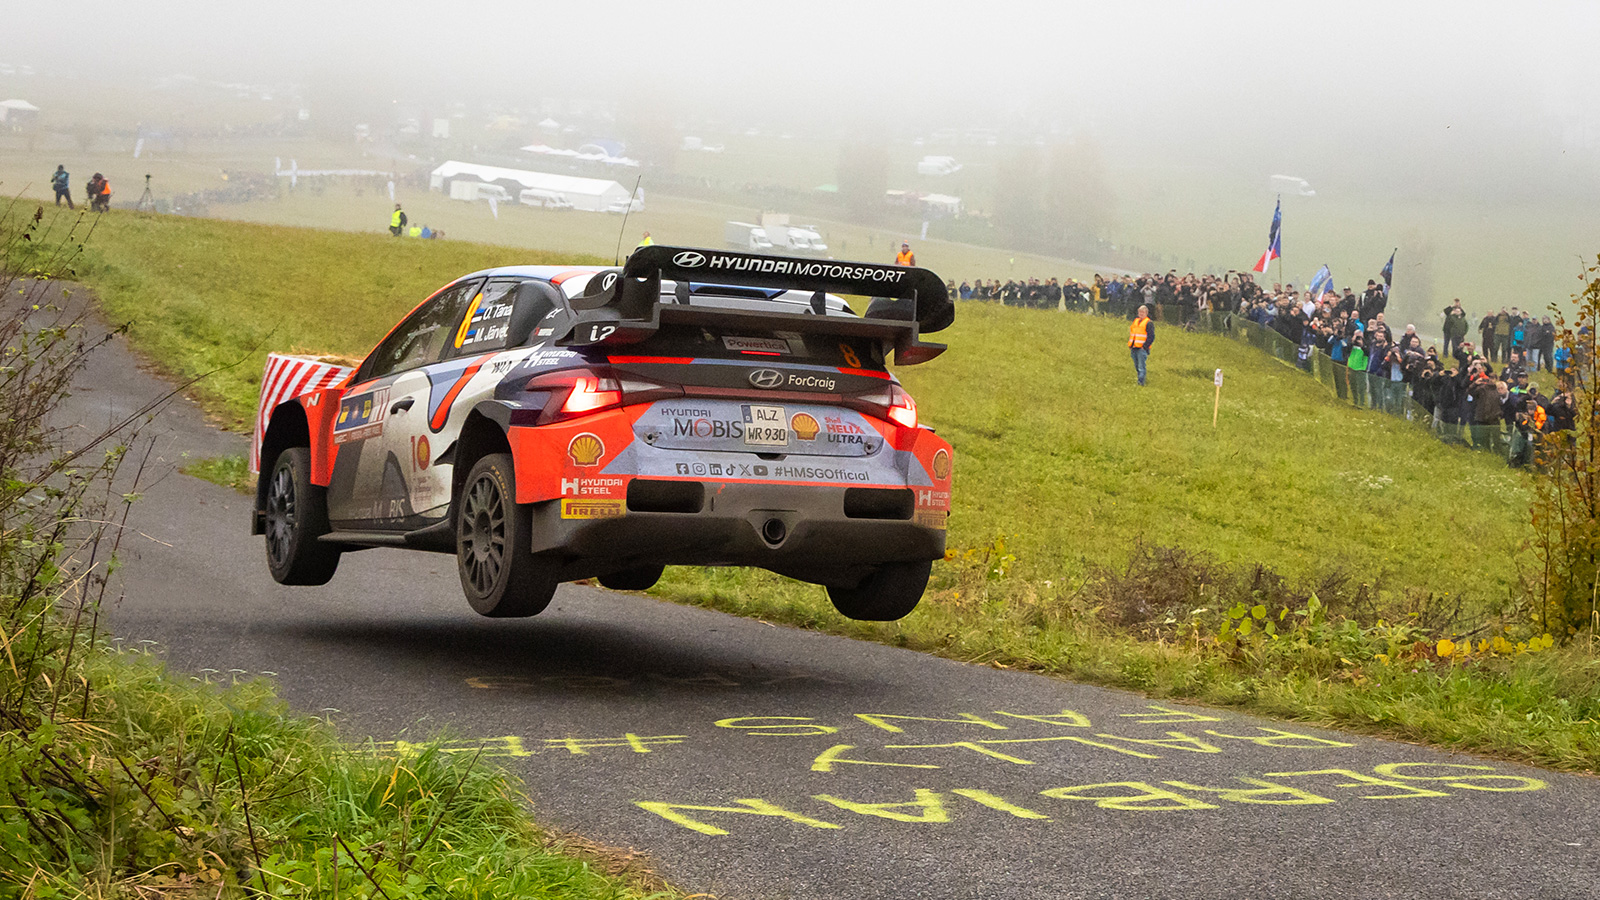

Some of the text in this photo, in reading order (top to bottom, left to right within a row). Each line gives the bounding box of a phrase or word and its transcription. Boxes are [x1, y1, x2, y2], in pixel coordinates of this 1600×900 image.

[709, 255, 906, 283] HYUNDAI MOTORSPORT
[454, 292, 484, 349] 8
[727, 339, 786, 351] Powertica
[537, 357, 560, 366] STEEL
[840, 343, 861, 368] 8
[788, 374, 836, 390] ForCraig
[661, 408, 711, 418] HYUNDAI
[757, 409, 779, 422] ALZ
[674, 418, 743, 439] MOBIS
[748, 427, 786, 441] WR 930
[826, 424, 865, 435] HELIX
[828, 434, 864, 445] ULTRA
[774, 466, 870, 482] #HMSGOfficial
[580, 478, 623, 486] HYUNDAI
[580, 487, 612, 495] STEEL
[565, 502, 621, 516] PIRELLI
[713, 705, 1221, 737] FANS
[810, 726, 1355, 772] RALLY
[634, 761, 1548, 836] SERBIAN
